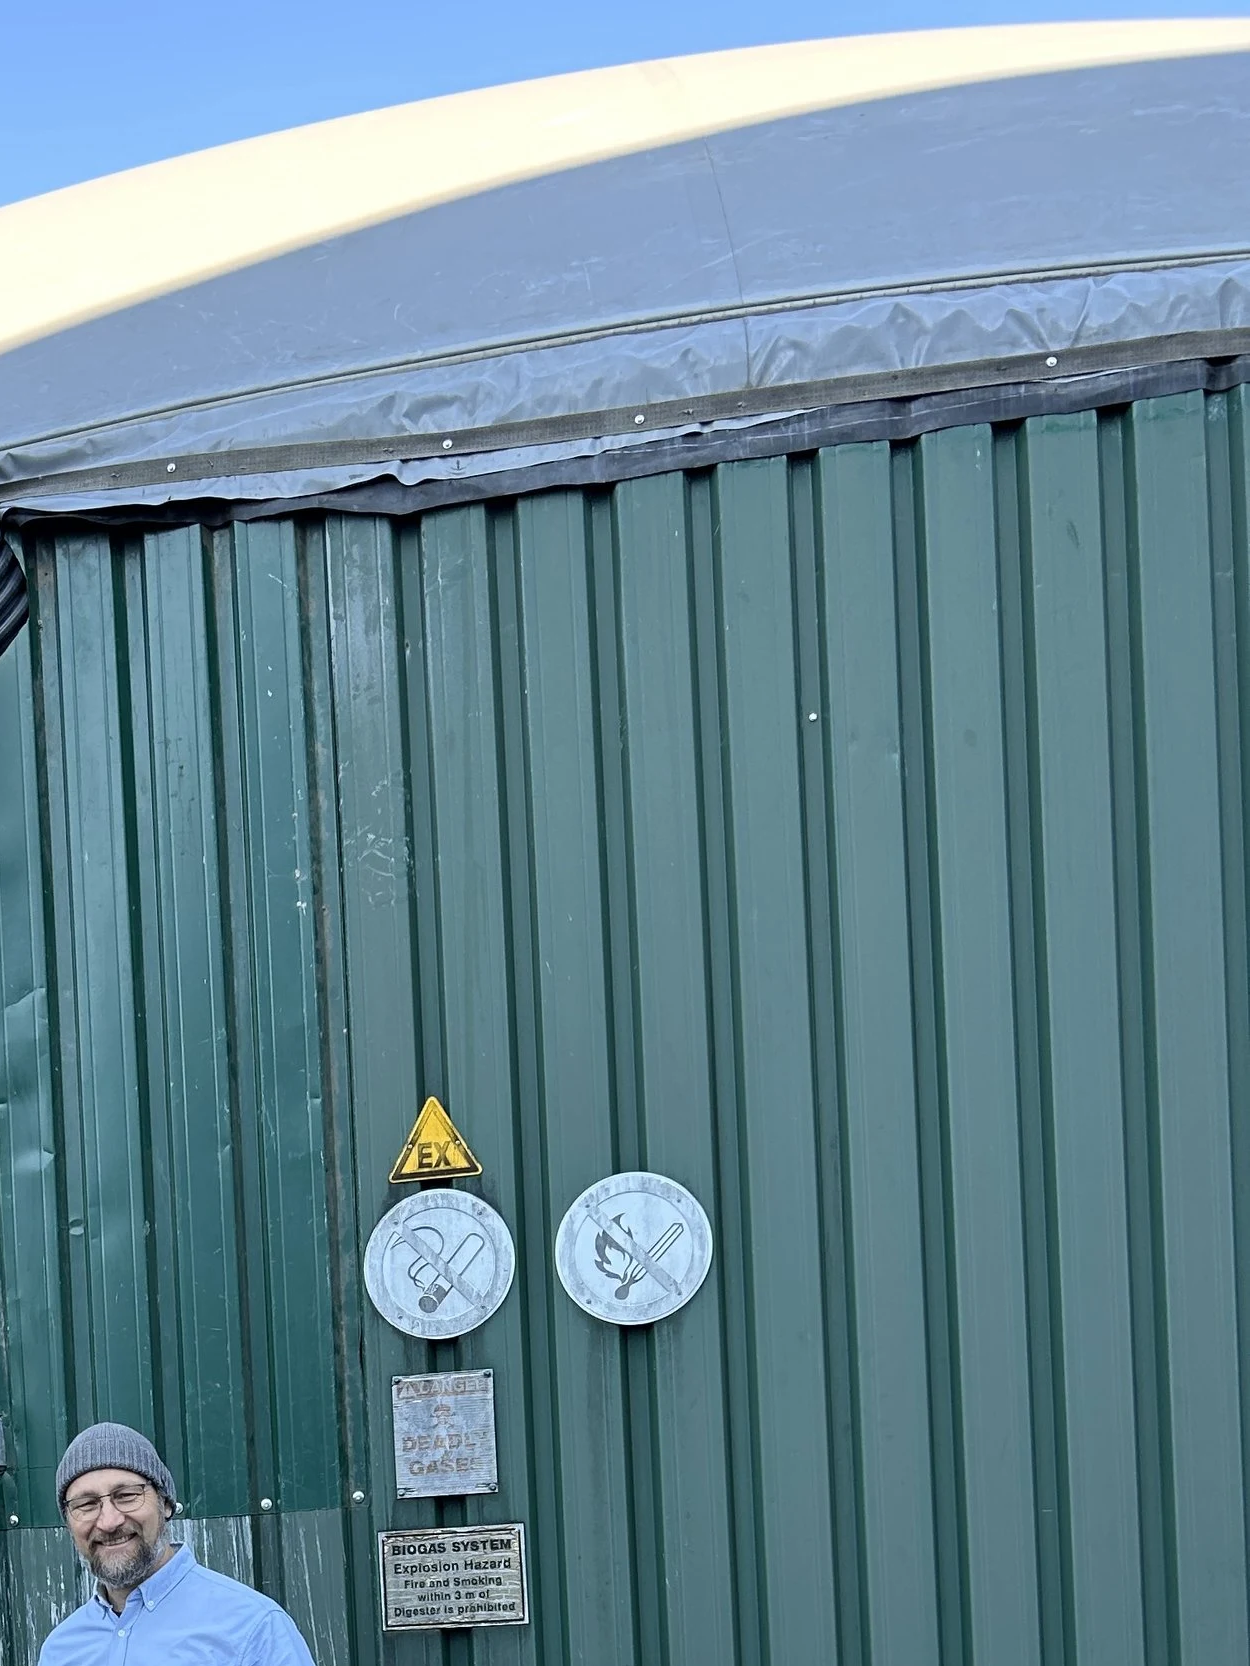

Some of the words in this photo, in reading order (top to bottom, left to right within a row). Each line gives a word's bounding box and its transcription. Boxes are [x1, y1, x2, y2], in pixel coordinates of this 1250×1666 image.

[417, 1140, 452, 1169] EX
[391, 1542, 447, 1556] BIOGAS
[451, 1539, 512, 1553] SYSTEM
[393, 1560, 459, 1576] Explosion
[463, 1557, 512, 1571] Hazard
[403, 1580, 426, 1589] Fire
[428, 1577, 450, 1588] and
[453, 1575, 503, 1587] Smoking
[417, 1591, 451, 1602] within
[454, 1591, 462, 1600] 3
[465, 1592, 475, 1600] m
[478, 1589, 491, 1599] of
[394, 1606, 441, 1618] Digester
[444, 1605, 454, 1614] is
[457, 1602, 516, 1616] prohibited
